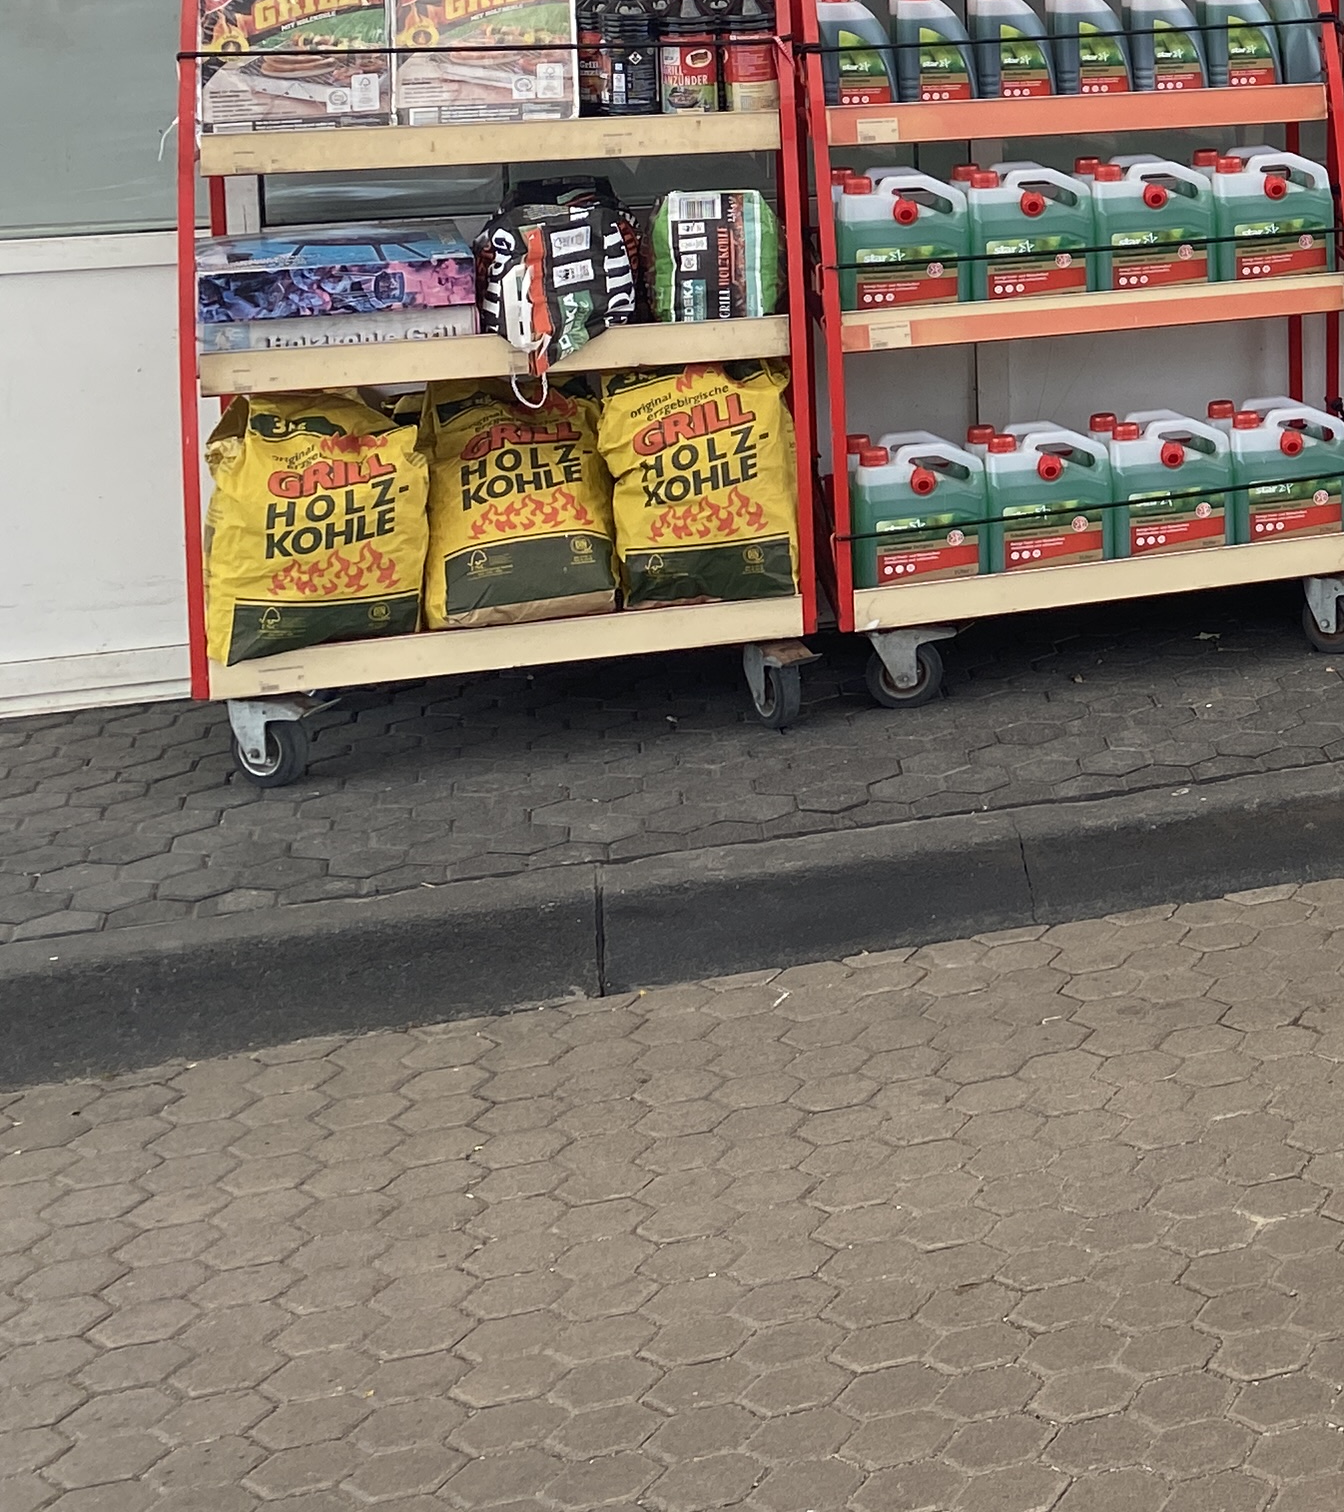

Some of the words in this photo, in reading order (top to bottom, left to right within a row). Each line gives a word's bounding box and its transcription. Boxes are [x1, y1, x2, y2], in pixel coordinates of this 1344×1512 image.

[842, 63, 859, 72] star
[922, 60, 939, 68] star
[1003, 57, 1019, 65] star
[1081, 53, 1098, 61] star
[994, 245, 1018, 254] star
[1119, 237, 1141, 245] star
[1241, 228, 1263, 236] star
[717, 227, 730, 286] HOLZKOHLE
[863, 254, 887, 263] star
[682, 279, 694, 322] EDEKA
[719, 288, 731, 319] GRILL
[630, 392, 672, 419] original
[646, 384, 729, 421] erzgebirgische
[272, 418, 286, 433] 3
[460, 422, 583, 460] GRILL
[633, 393, 756, 456] GRILL
[460, 443, 593, 487] HOLZ-
[639, 425, 769, 483] HOLZ-
[267, 453, 397, 498] GRILL
[462, 462, 583, 511] KOHLE
[642, 452, 758, 508] KOHLE
[265, 477, 410, 530] HOLZ-
[265, 506, 396, 559] KOHLE
